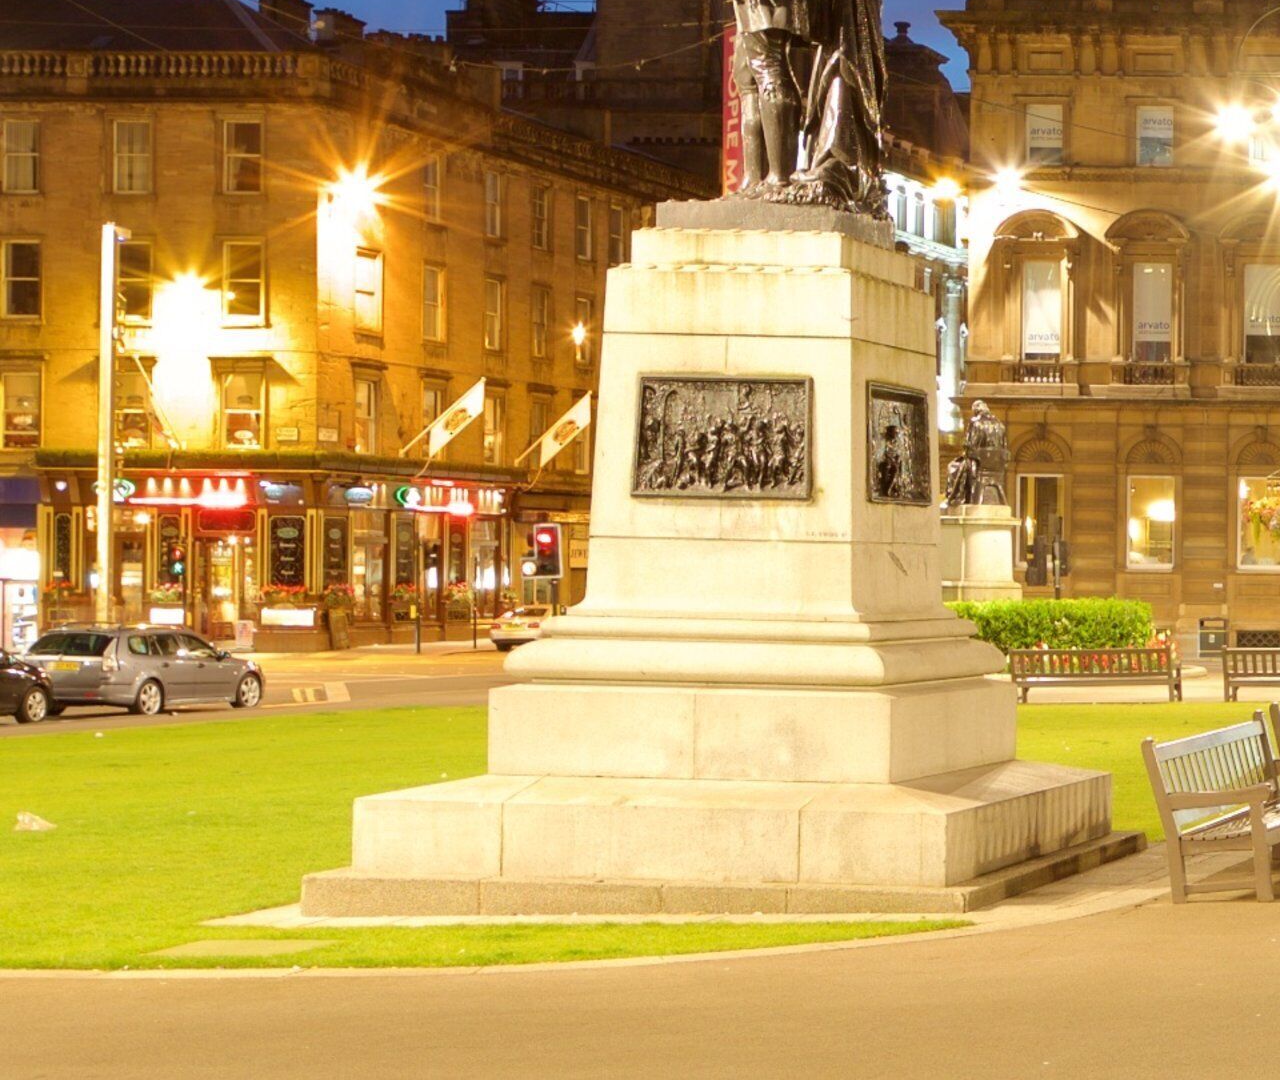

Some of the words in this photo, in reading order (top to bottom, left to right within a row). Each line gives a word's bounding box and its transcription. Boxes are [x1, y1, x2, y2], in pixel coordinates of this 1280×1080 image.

[1143, 117, 1173, 126] arvato
[1030, 127, 1063, 136] arvato
[1138, 321, 1170, 330] arvato
[1028, 332, 1060, 341] arvato
